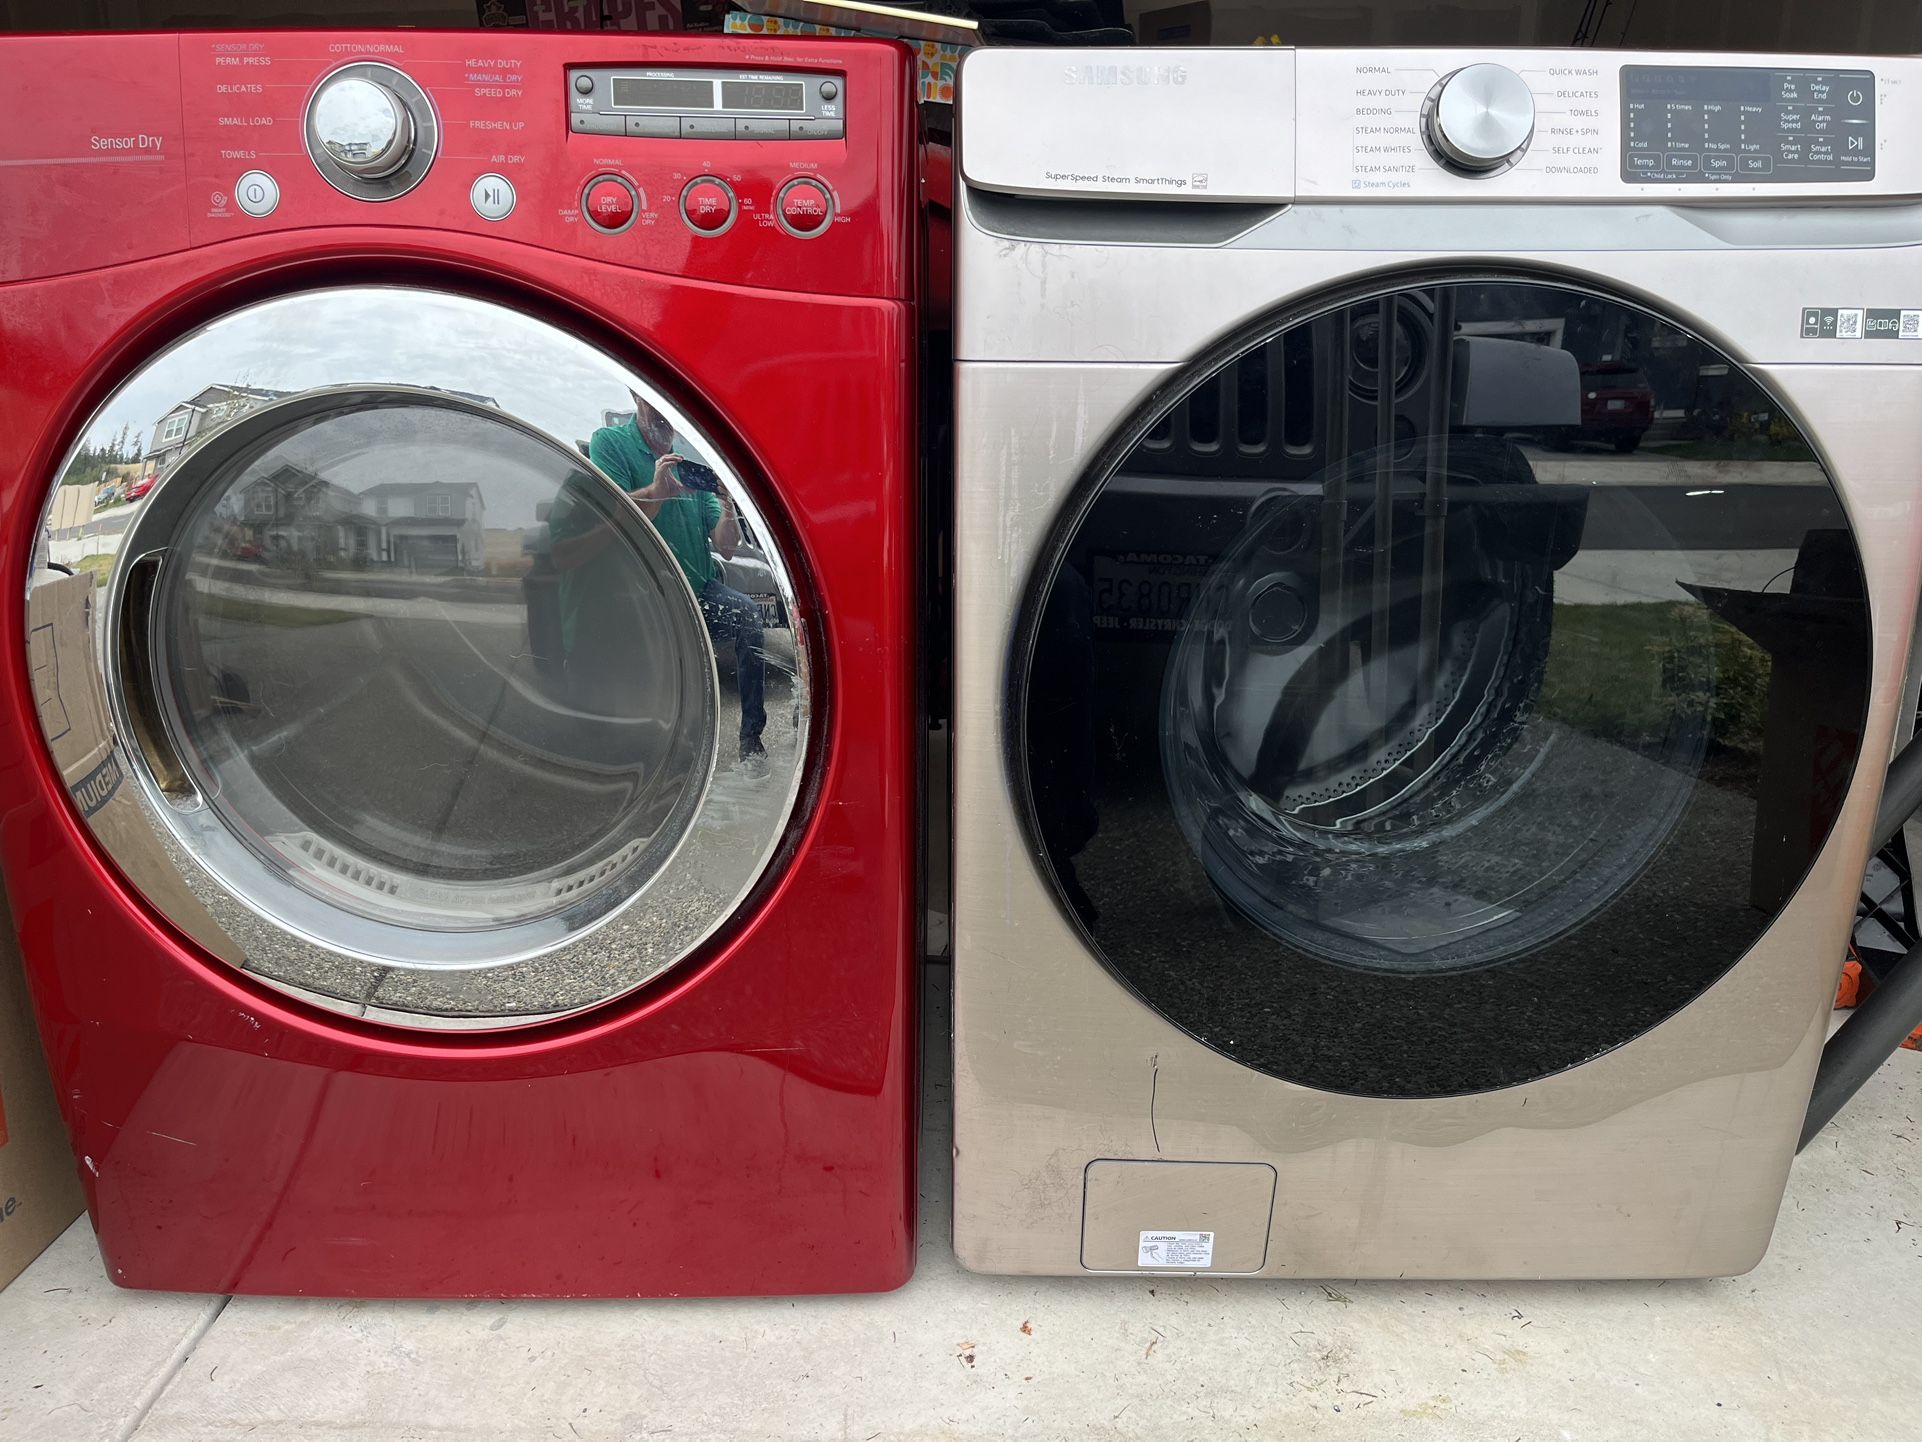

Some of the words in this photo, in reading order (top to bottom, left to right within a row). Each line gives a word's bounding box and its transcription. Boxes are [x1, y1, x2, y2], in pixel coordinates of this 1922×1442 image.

[329, 44, 404, 53] COTTON/NORMAL
[243, 57, 271, 65] PRESS
[466, 59, 494, 68] HEAVY
[497, 60, 522, 68] DUTY
[1064, 65, 1188, 86] SAMSUNG
[1549, 68, 1573, 76] QUICK
[506, 74, 522, 82] DRY
[217, 85, 262, 93] DELICATES
[1810, 84, 1829, 92] Delay
[475, 88, 502, 97] SPEED
[505, 89, 522, 97] DRY
[1356, 89, 1383, 97] HEAVY
[1385, 89, 1406, 97] DUTY
[1557, 90, 1599, 99] DELICATES
[1814, 92, 1826, 100] End
[1356, 108, 1392, 116] BEDDING
[1570, 109, 1599, 117] TOWELS
[1745, 105, 1762, 113] Heavy
[1781, 113, 1800, 121] Super
[219, 117, 247, 126] SMALL
[249, 117, 273, 126] LOAD
[470, 121, 509, 130] FRESHEN
[512, 122, 525, 130] UP
[1781, 122, 1801, 130] Speed
[1815, 122, 1826, 130] Off
[1550, 128, 1574, 136] RINSE
[1581, 128, 1599, 136] SPIN
[91, 136, 135, 150] Sensor
[138, 134, 162, 151] Dry
[221, 150, 256, 159] TOWELS
[1783, 152, 1799, 160] Care
[1809, 153, 1833, 161] Control
[491, 155, 505, 164] AIR
[508, 155, 525, 164] DRY
[1633, 158, 1655, 167] Temp.
[1672, 158, 1692, 166] Rinse
[1710, 158, 1727, 168] Spin
[1748, 160, 1762, 168] Soil
[1355, 165, 1381, 173] STEAM
[1383, 165, 1416, 173] SANITIZE
[1545, 166, 1599, 175] DOWNLOADED
[672, 172, 681, 180] 30
[1045, 171, 1099, 182] SuperSpeed
[1102, 175, 1131, 184] Steam
[1134, 176, 1187, 188] SmartThings
[1363, 180, 1387, 188] Steam
[1387, 180, 1410, 189] Cycles
[697, 198, 717, 206] TIME
[793, 199, 816, 207] TEMP.
[785, 207, 823, 216] CONTROL
